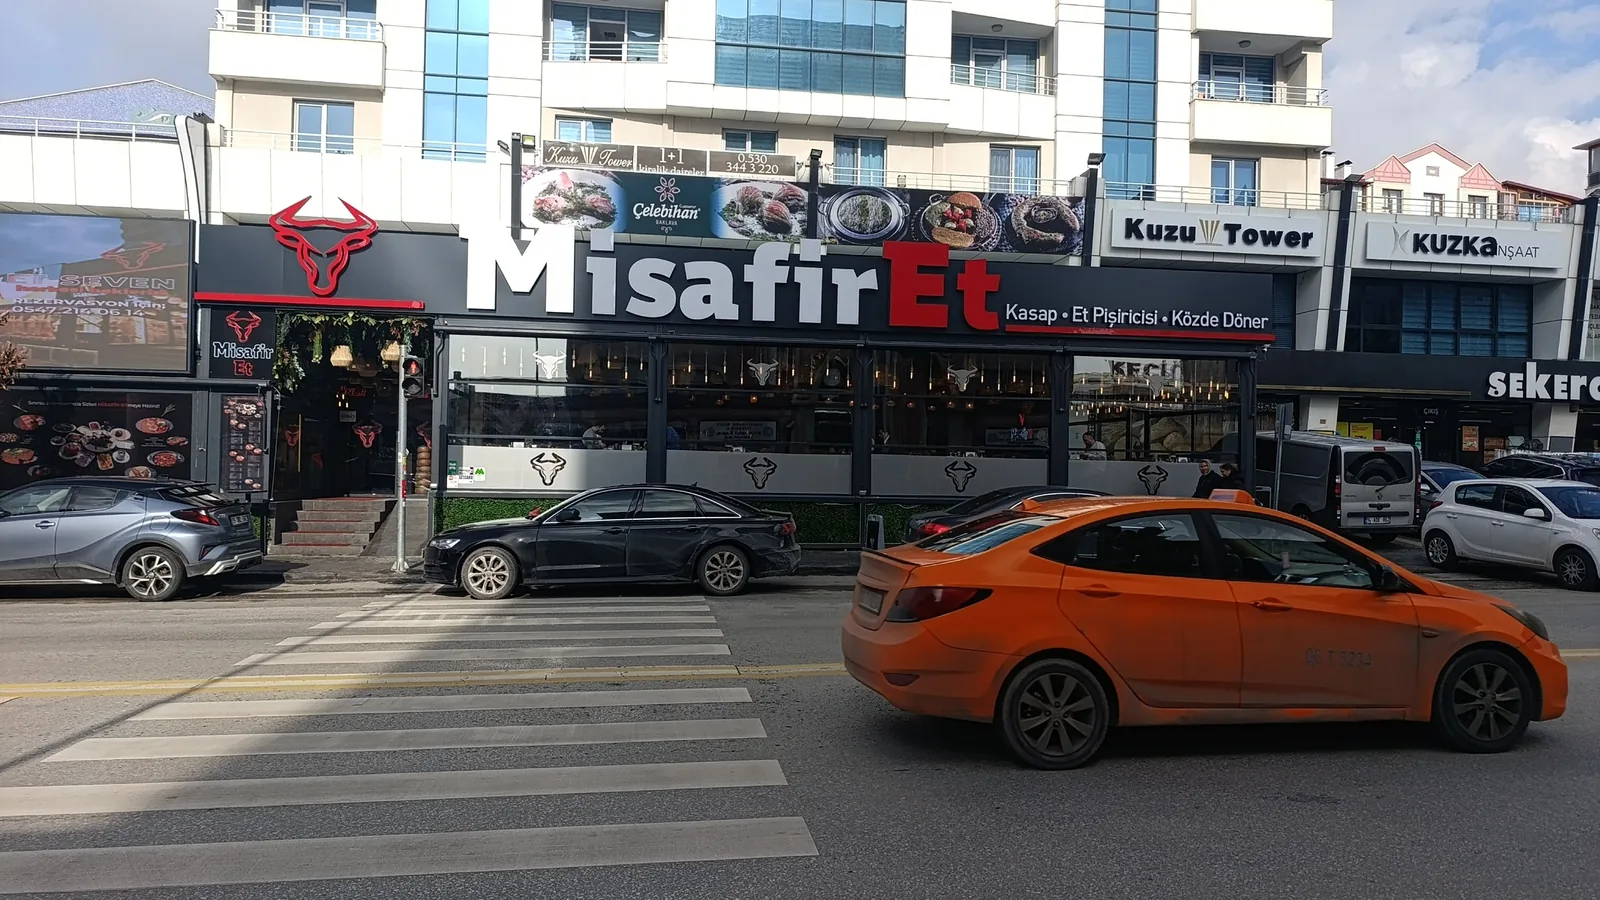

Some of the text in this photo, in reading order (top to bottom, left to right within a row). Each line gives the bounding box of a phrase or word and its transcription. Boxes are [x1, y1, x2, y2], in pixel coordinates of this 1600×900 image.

[545, 146, 634, 167] Kuzu Tower
[659, 147, 684, 164] 1+1
[737, 152, 768, 164] 0.530
[726, 162, 779, 175] 344 3 220
[633, 203, 698, 219] Çelebihan
[1124, 218, 1314, 248] Kuzu Tower
[60, 275, 175, 289] SEVEN
[14, 298, 128, 308] REZERVASYON
[12, 306, 145, 317] 0547 214 06 14
[1005, 304, 1269, 330] Kasap Et Pişiricisi Közde Döner
[212, 342, 274, 360] Misafir
[232, 360, 254, 376] Et
